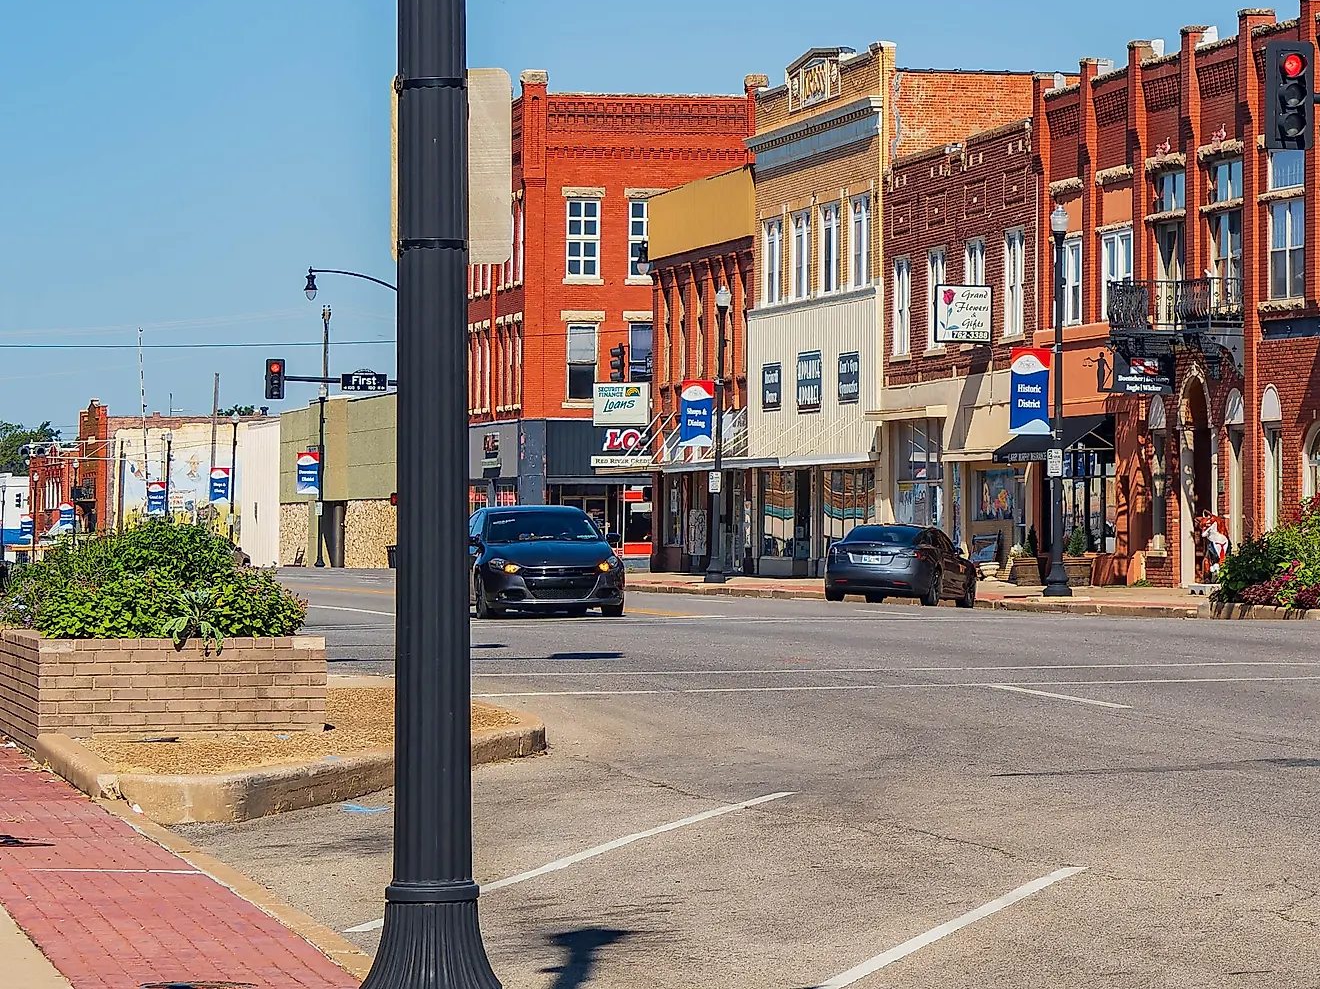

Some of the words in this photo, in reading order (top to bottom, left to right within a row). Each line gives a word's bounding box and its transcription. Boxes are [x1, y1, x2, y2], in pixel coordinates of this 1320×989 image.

[961, 289, 988, 300] Grand
[955, 302, 989, 313] Flowers
[961, 318, 984, 330] Gifts
[953, 331, 988, 339] 762-3388
[797, 359, 820, 380] APPLAUSE
[351, 375, 377, 385] First
[1017, 383, 1042, 393] Historic
[798, 385, 820, 405] APPAREL
[602, 398, 636, 413] Loans
[1017, 398, 1041, 408] District
[686, 407, 701, 417] Shops
[702, 408, 708, 416] &
[687, 419, 706, 429] Dining
